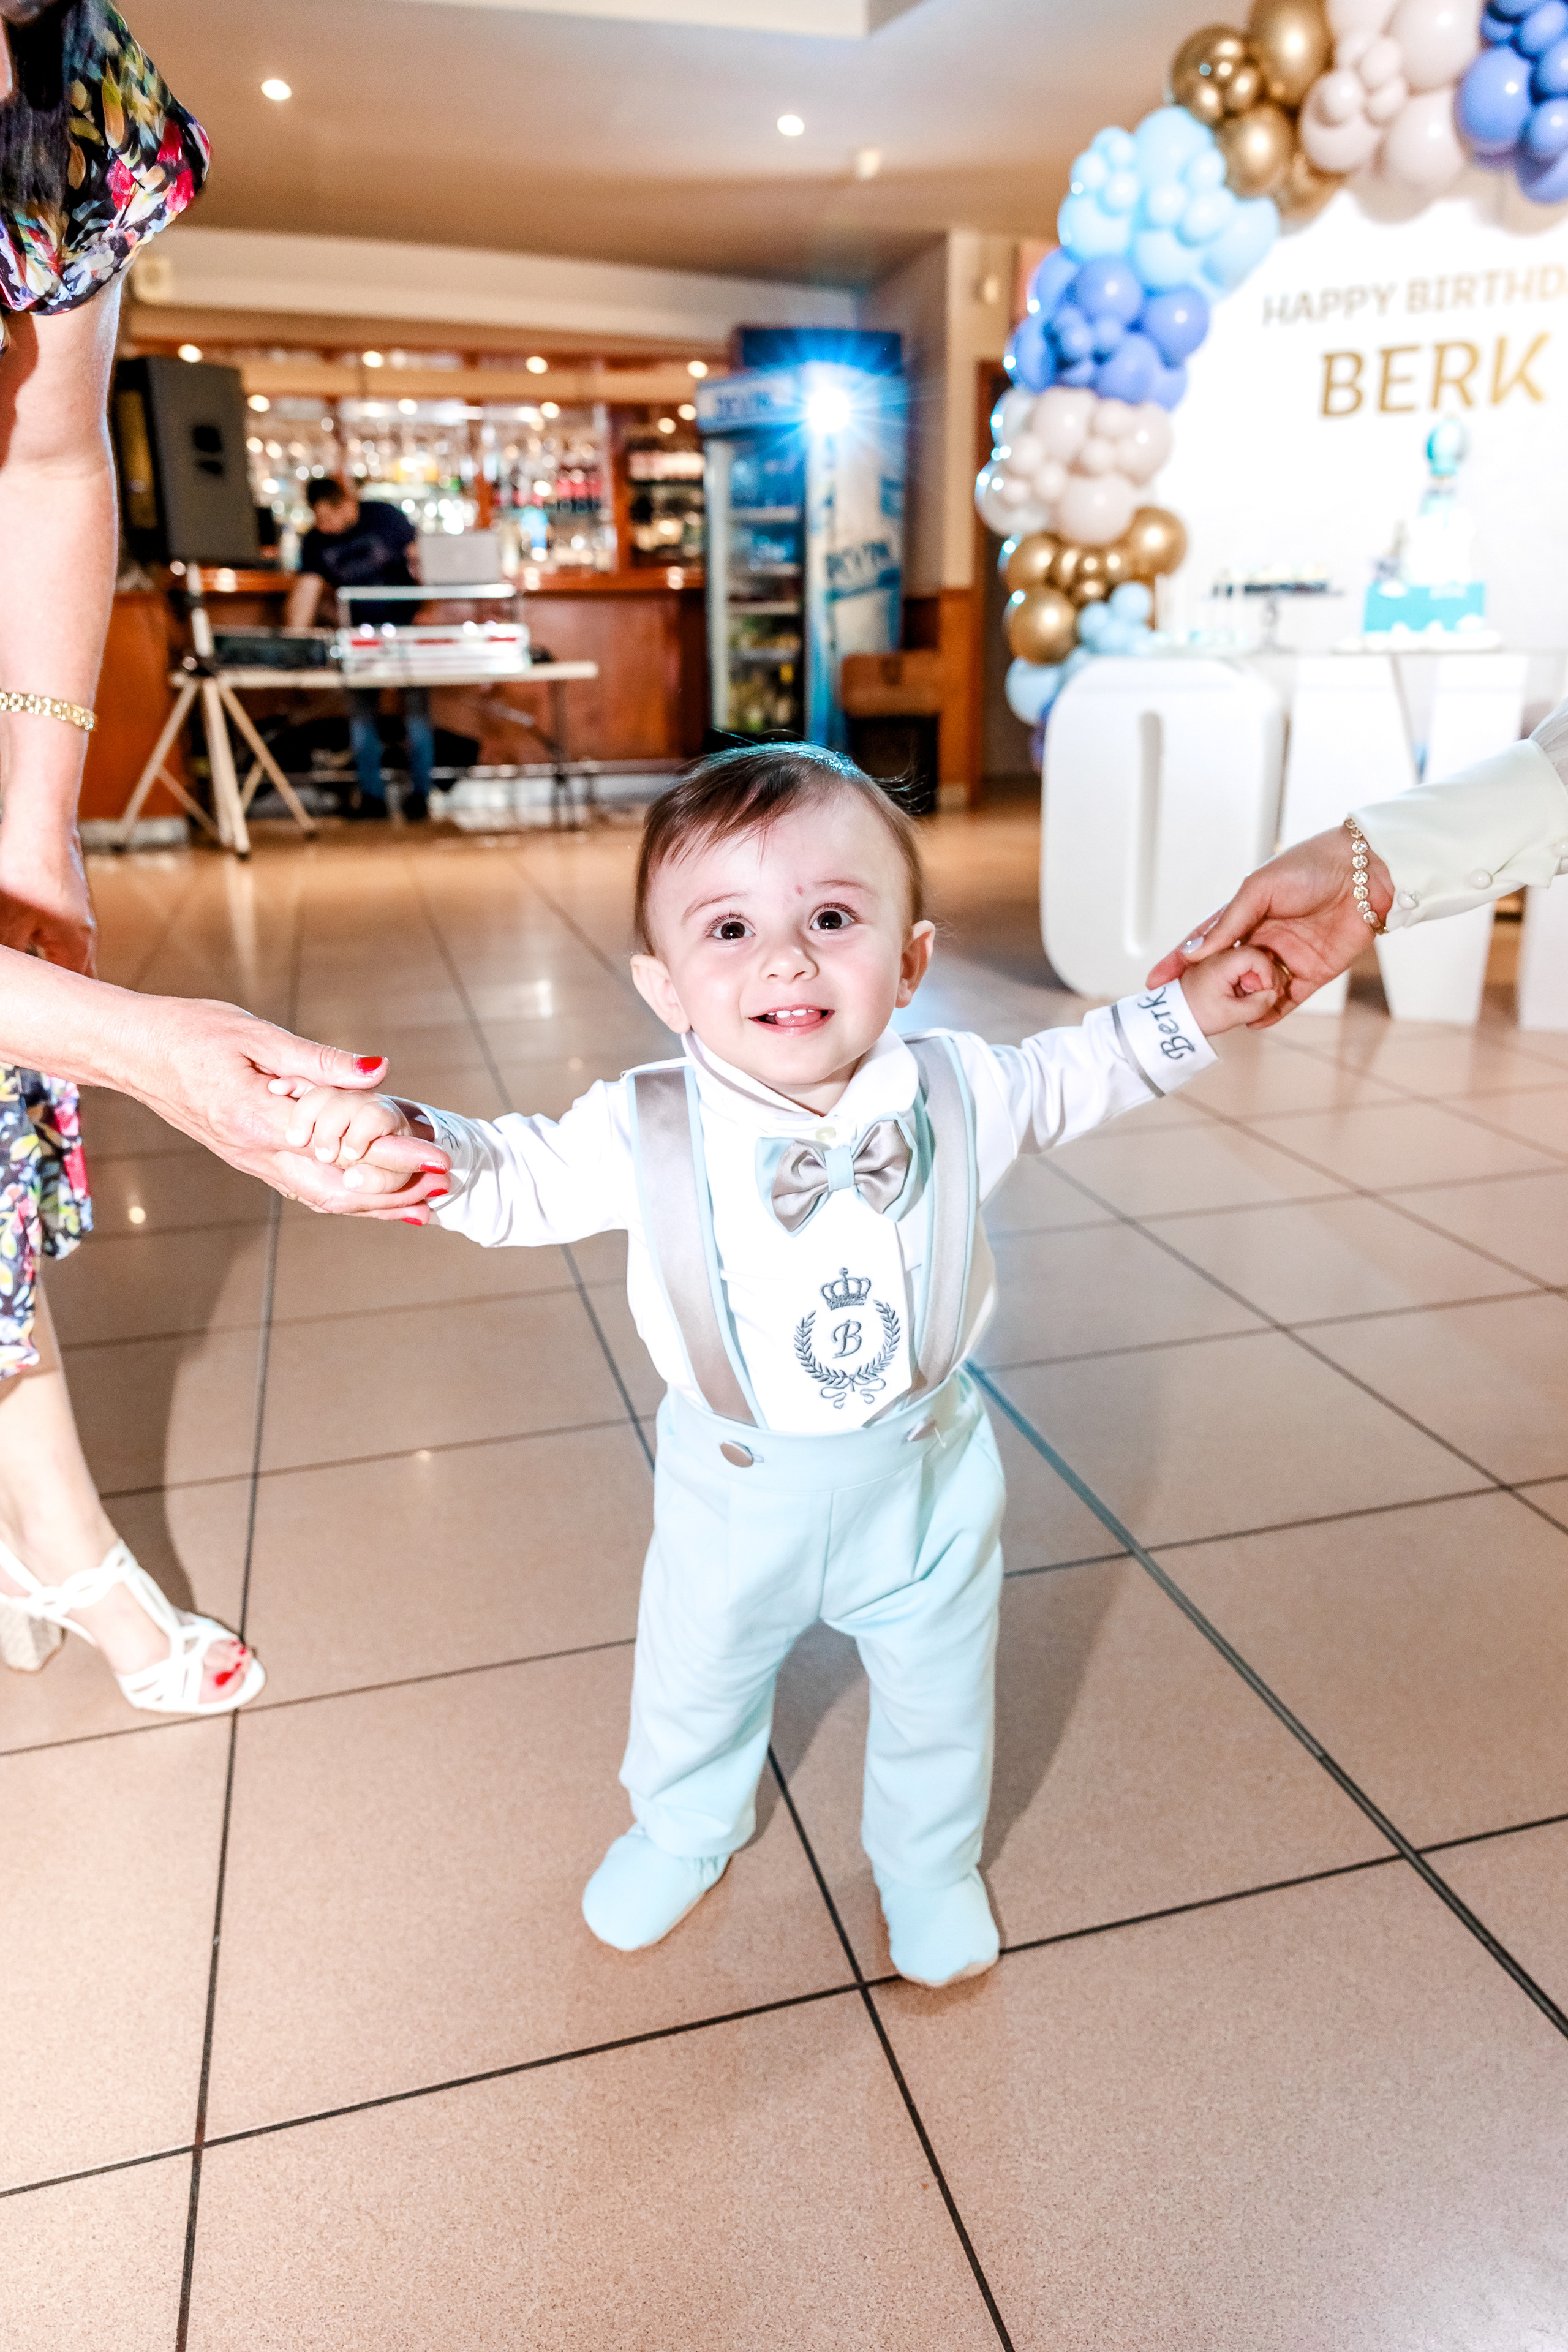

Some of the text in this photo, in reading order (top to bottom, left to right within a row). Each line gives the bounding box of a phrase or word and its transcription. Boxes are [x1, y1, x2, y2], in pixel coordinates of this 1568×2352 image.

[1262, 263, 1568, 326] HAPPY BIRTHD
[1319, 331, 1551, 419] BERK
[1137, 987, 1195, 1060] Berk
[832, 1319, 862, 1359] B
